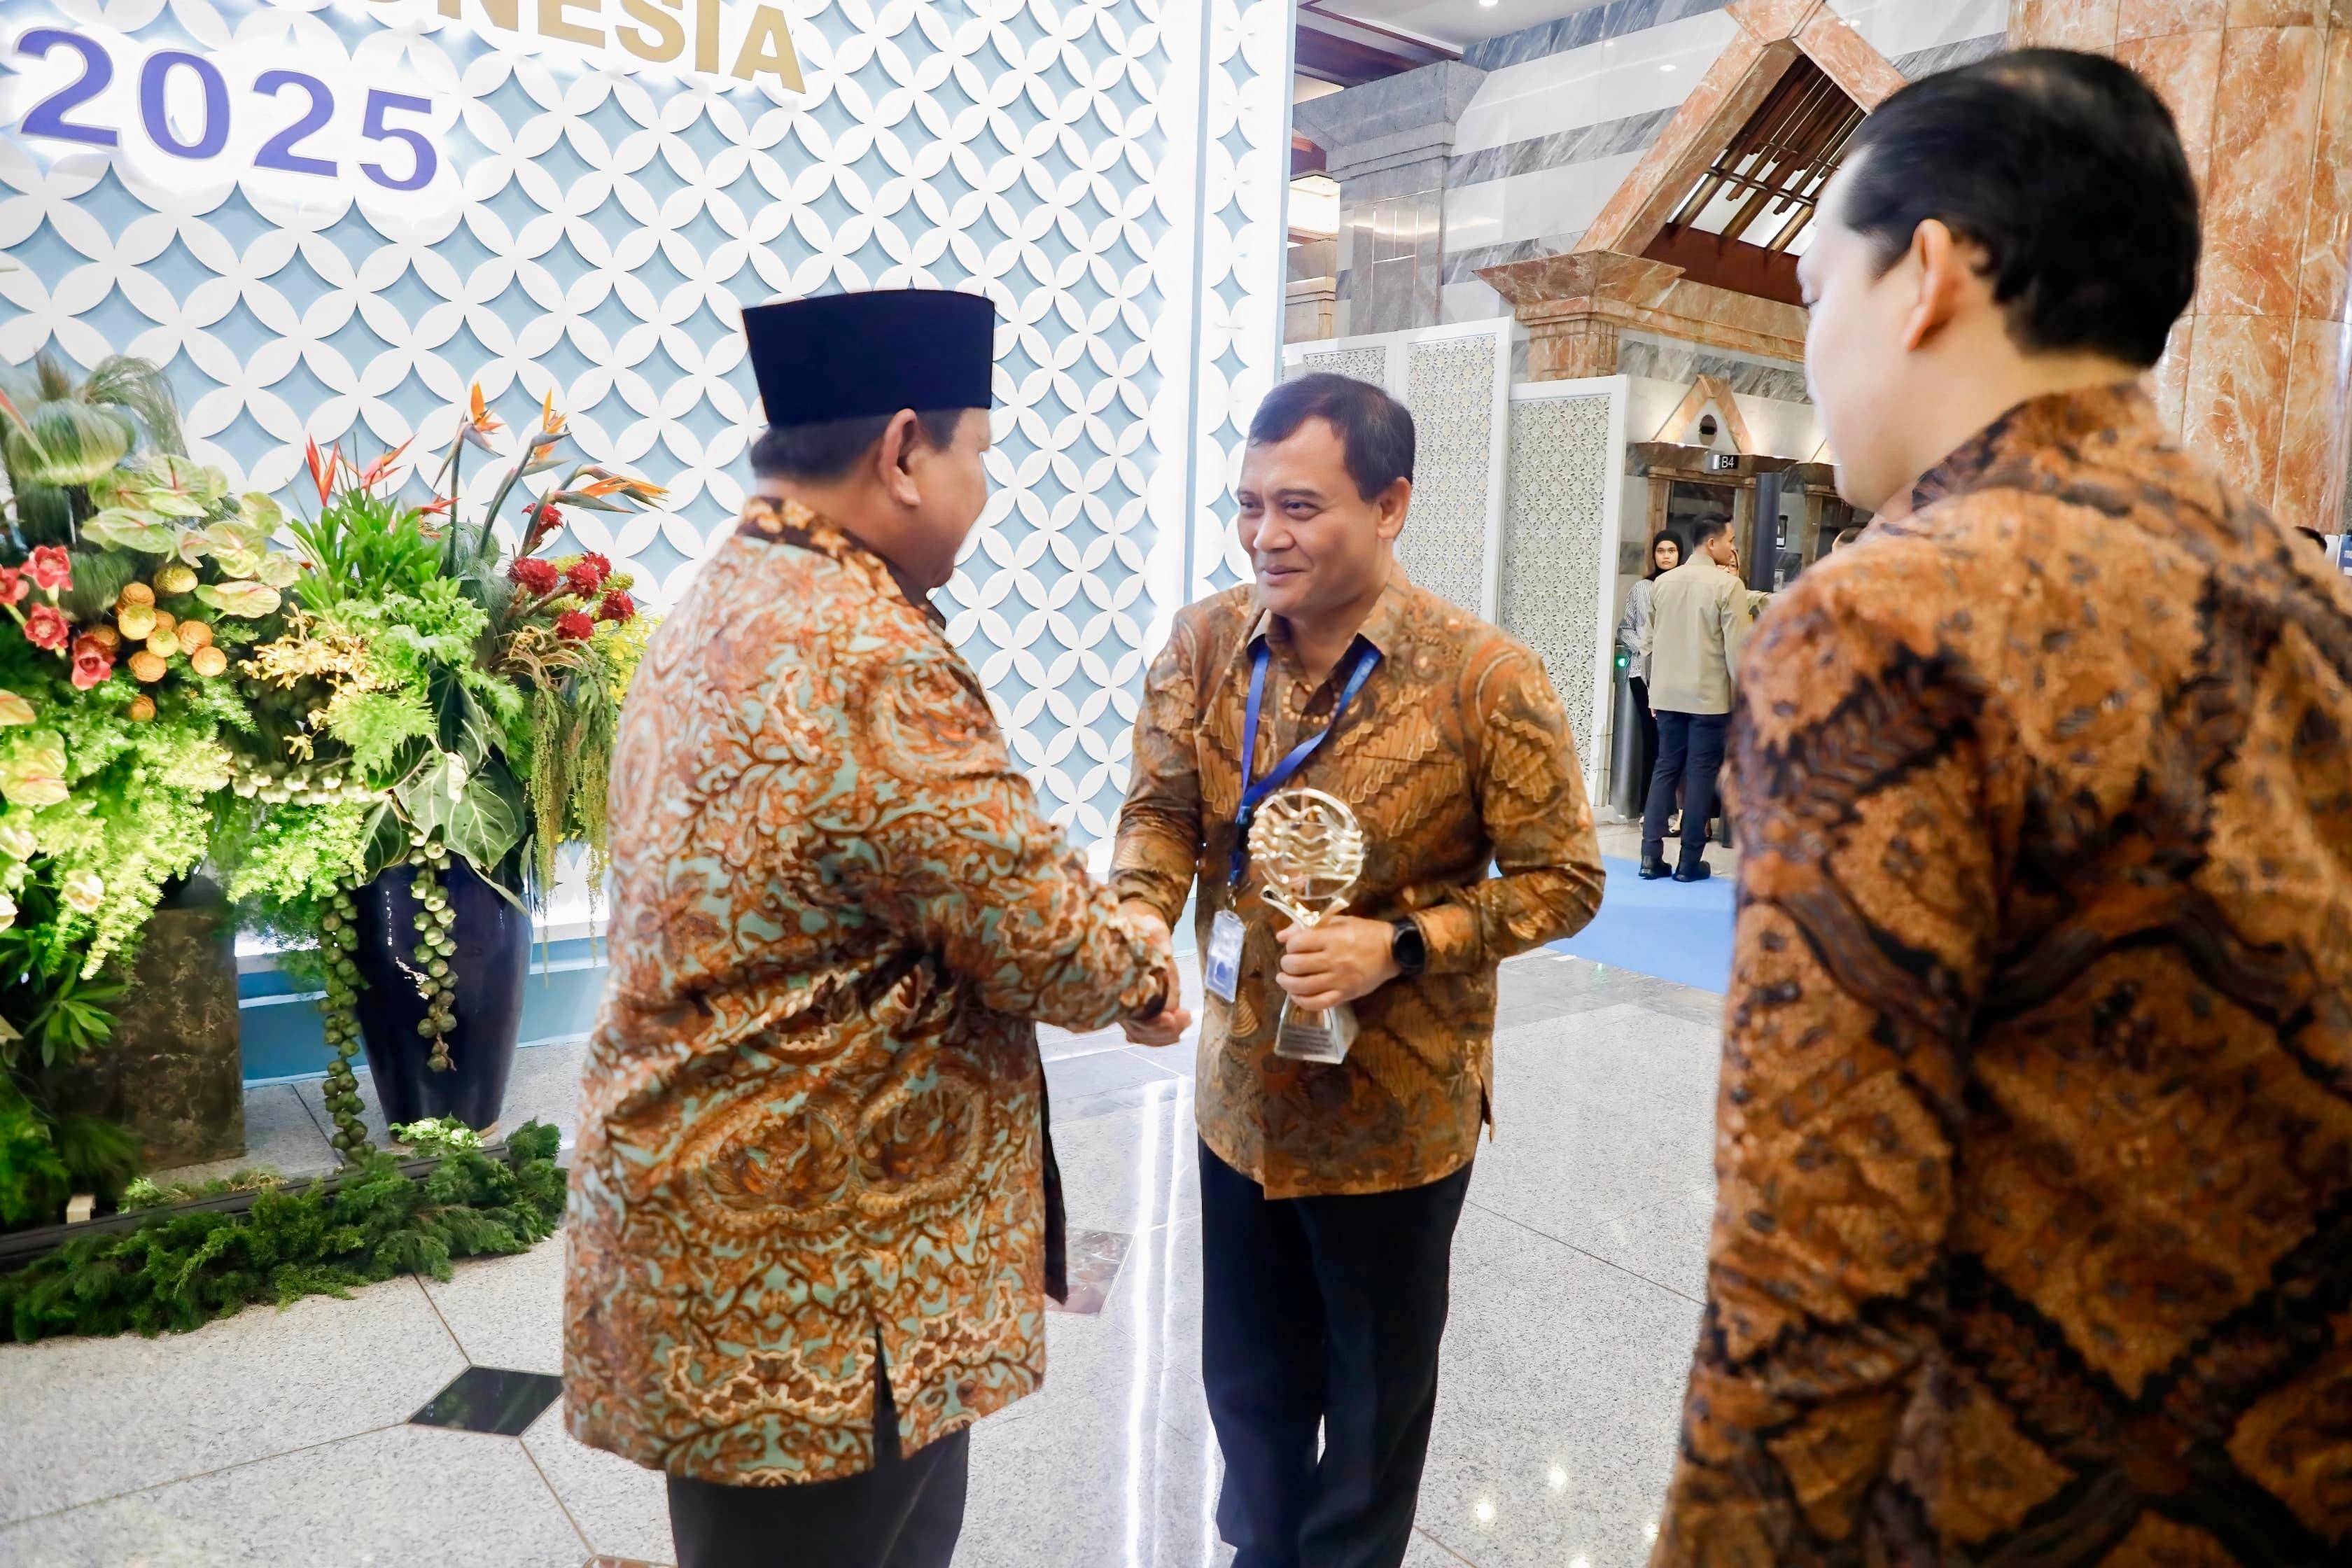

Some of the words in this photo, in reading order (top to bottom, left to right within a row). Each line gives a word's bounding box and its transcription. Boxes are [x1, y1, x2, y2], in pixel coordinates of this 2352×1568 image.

[366, 0, 806, 94] ESIA
[13, 26, 438, 191] 2025
[1721, 456, 1735, 468] B4
